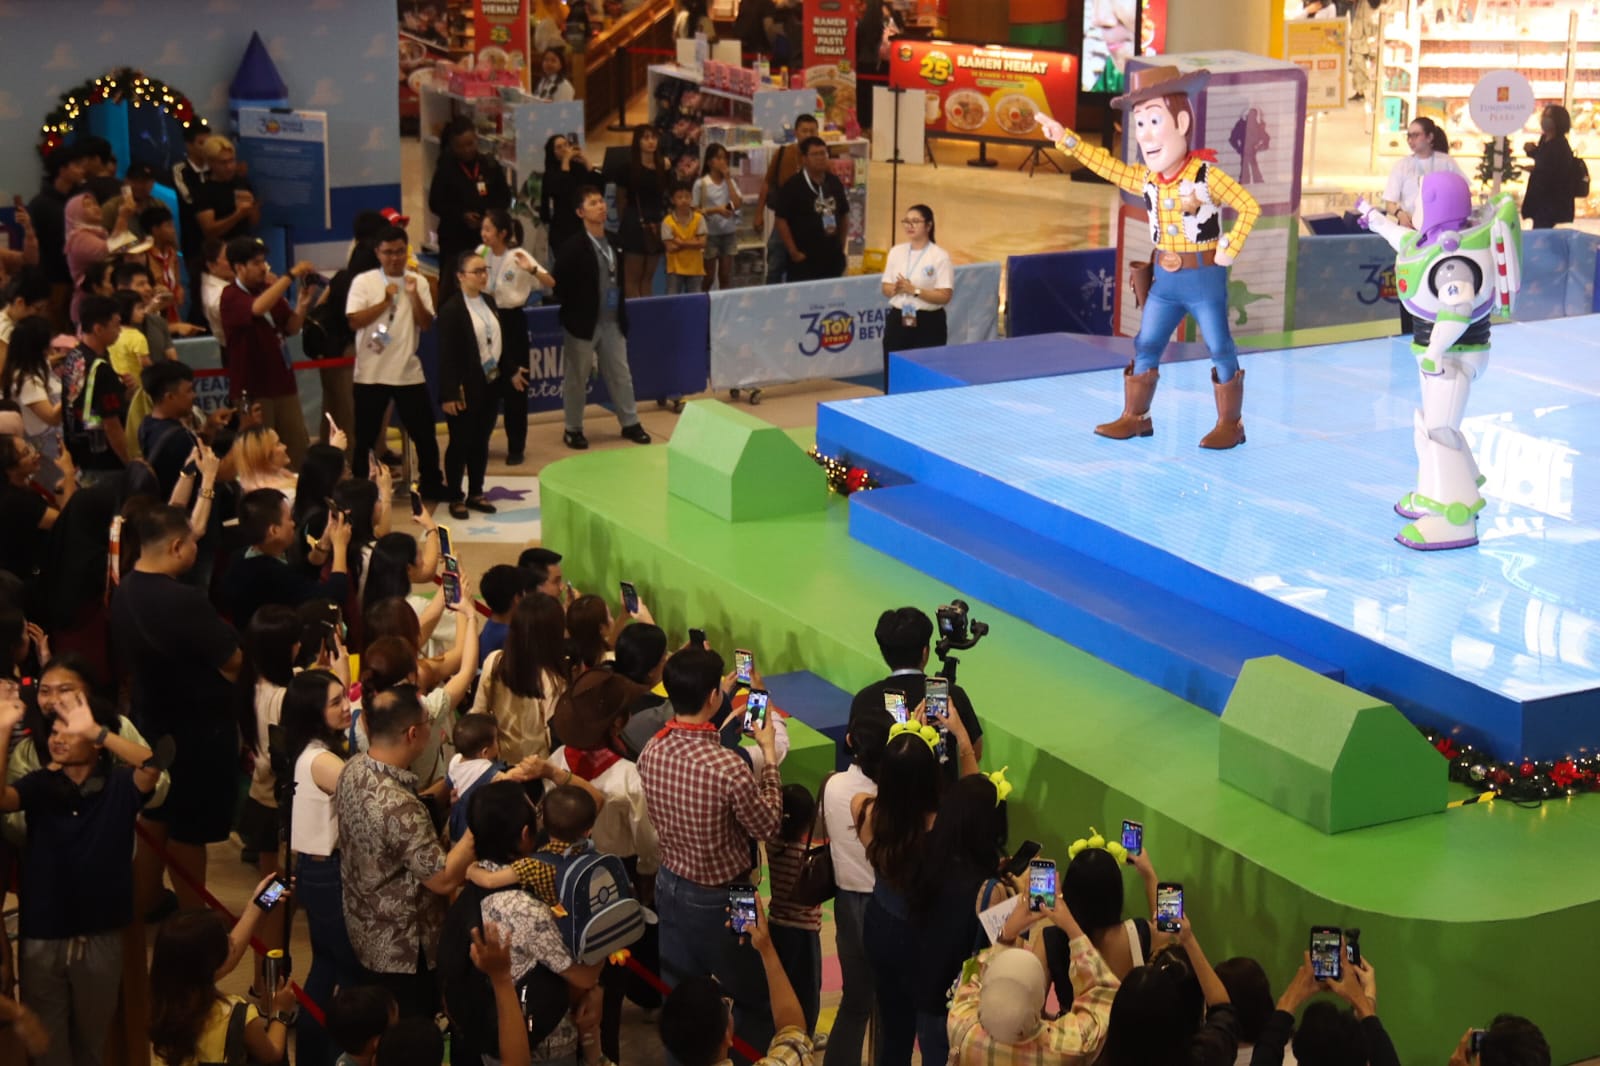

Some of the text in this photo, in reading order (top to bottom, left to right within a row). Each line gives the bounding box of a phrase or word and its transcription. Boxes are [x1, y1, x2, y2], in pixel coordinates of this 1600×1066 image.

[482, 4, 519, 14] HEMAT
[813, 17, 847, 26] RAMEN
[816, 36, 844, 46] PASTI
[814, 46, 846, 55] HEMAT
[921, 55, 948, 80] 25
[957, 55, 1048, 75] RAMEN HEMAT
[822, 315, 854, 337] TOY
